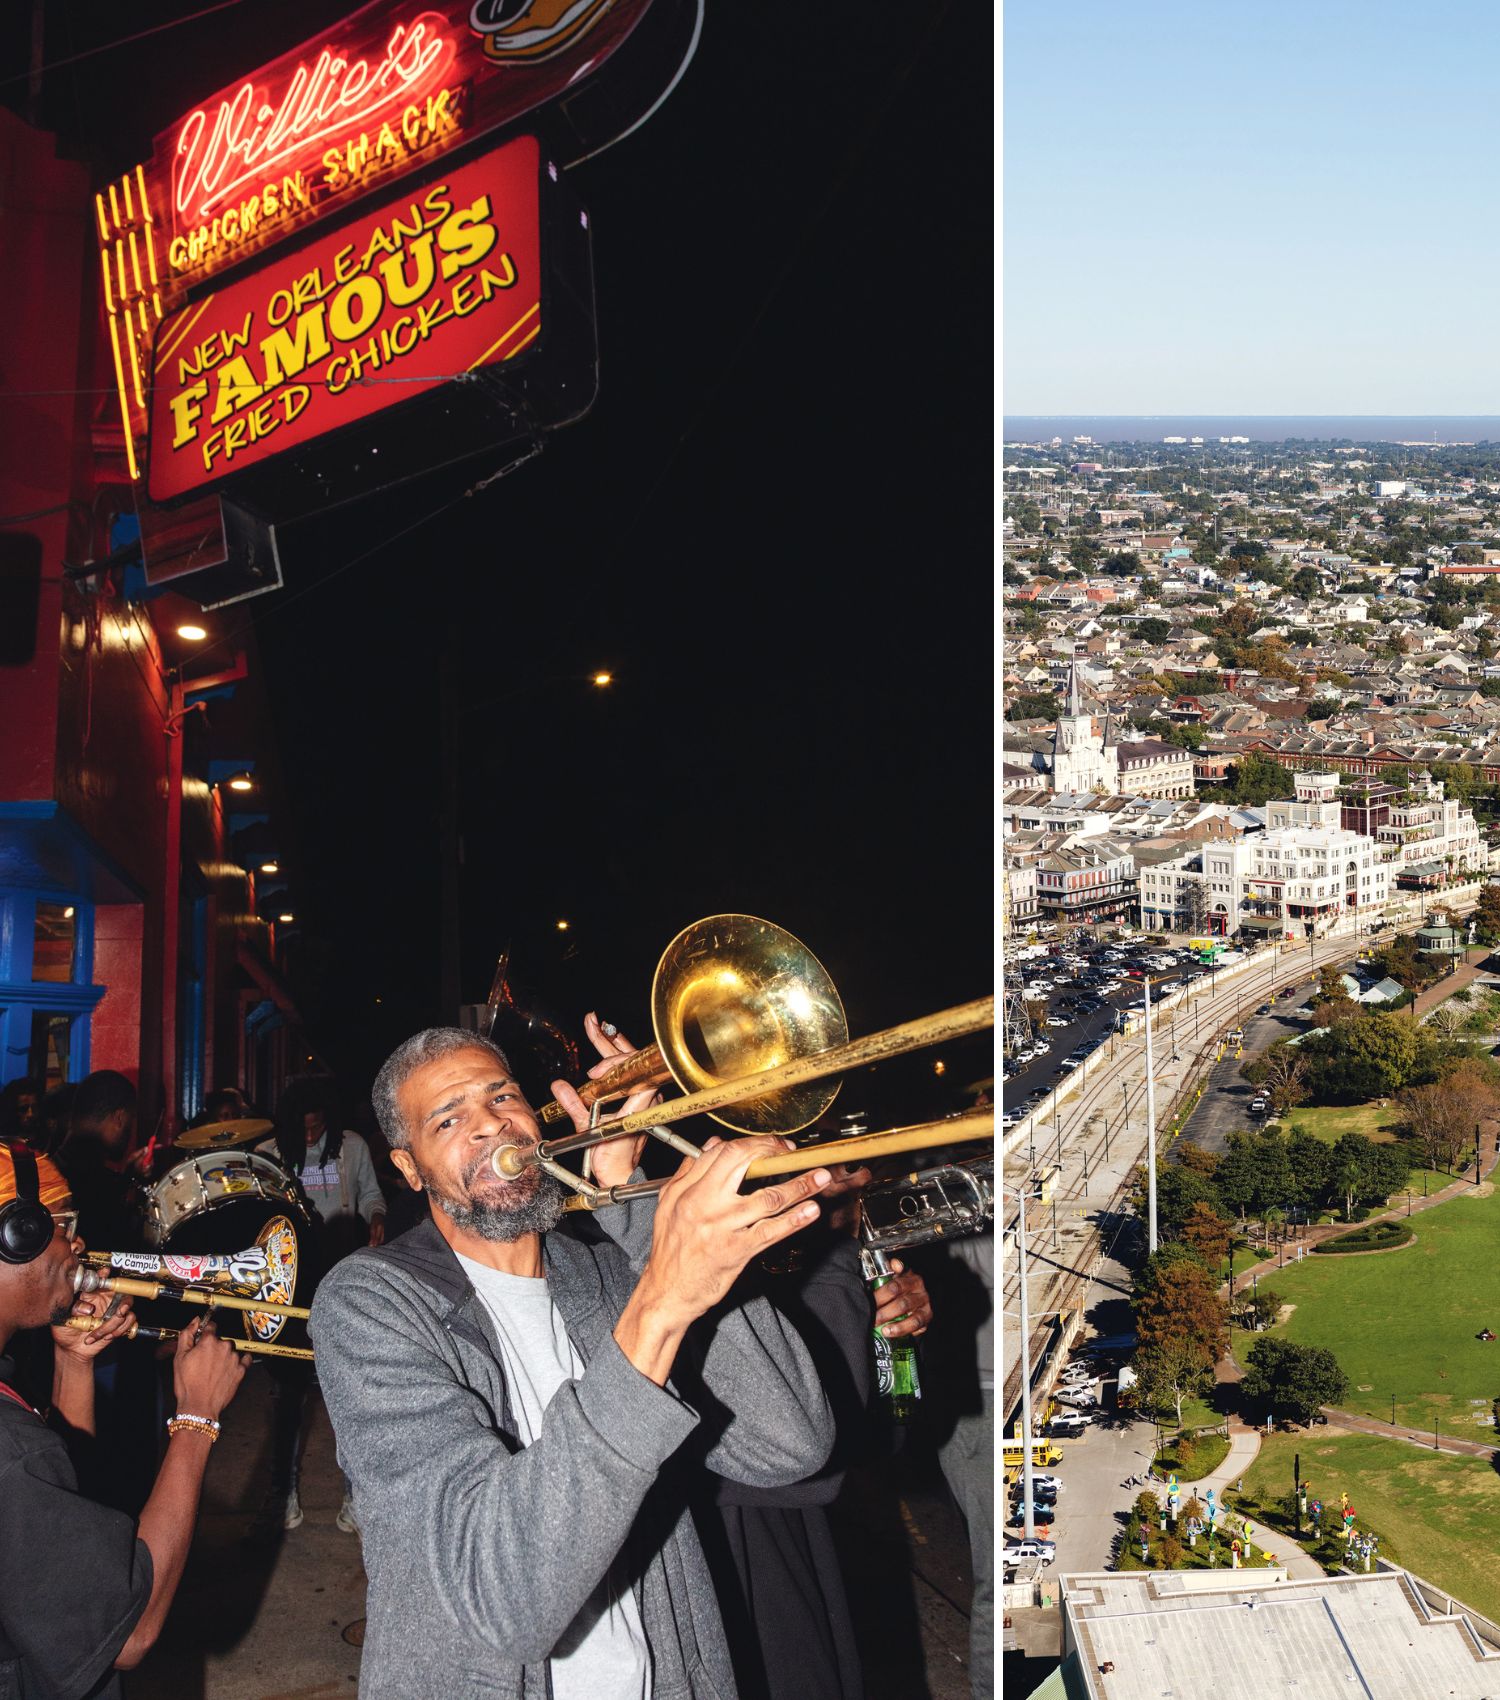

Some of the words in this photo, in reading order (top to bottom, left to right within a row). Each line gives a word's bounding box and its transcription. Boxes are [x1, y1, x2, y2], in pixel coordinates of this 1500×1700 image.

[169, 171, 304, 268] CHICKEN
[322, 89, 449, 184] SHACK
[177, 23, 443, 212] Willie's
[169, 195, 498, 449] FAMOUS
[178, 312, 252, 385] NEW
[267, 186, 454, 326] ORLEANS
[202, 385, 312, 471] FRIED
[326, 253, 517, 394] CHICKEN
[124, 1259, 158, 1270] Campus
